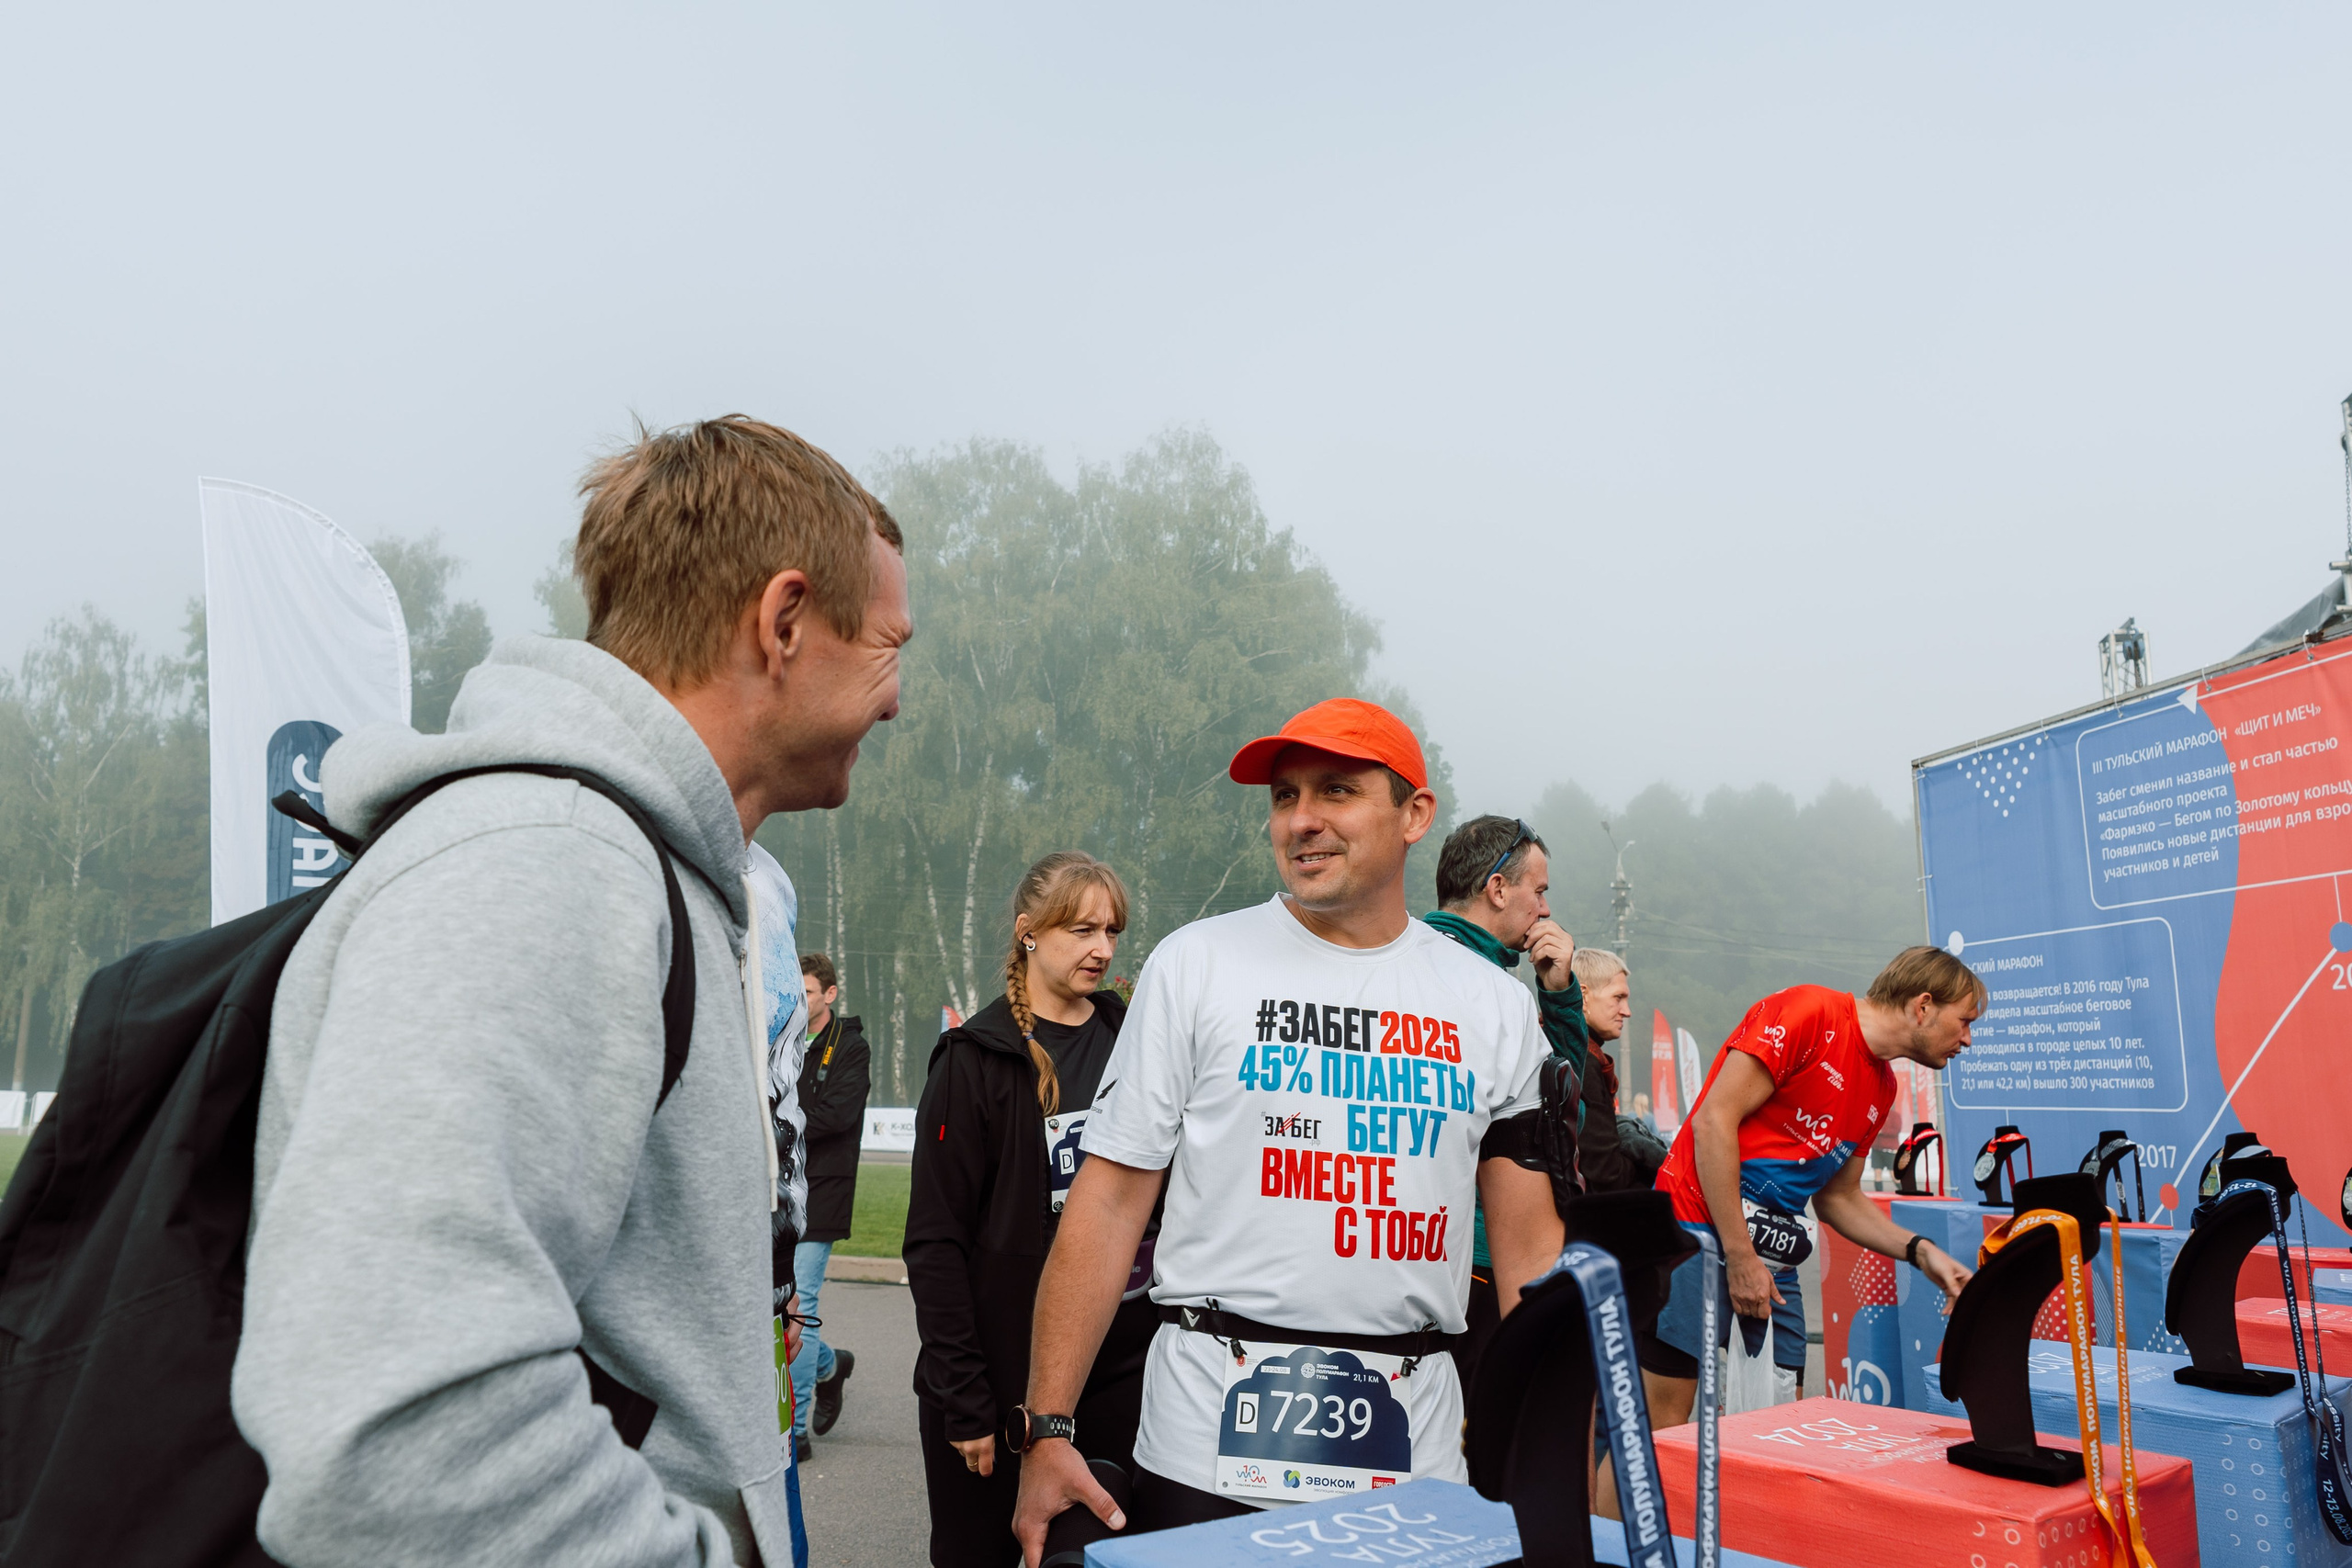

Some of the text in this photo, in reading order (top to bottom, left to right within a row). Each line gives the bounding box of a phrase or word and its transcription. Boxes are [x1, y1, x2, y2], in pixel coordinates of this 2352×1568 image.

[2105, 741, 2163, 771] ТУЛЬСКИЙ
[2166, 727, 2227, 755] МАРАФОН
[2234, 715, 2269, 736] «ЩИТ
[2273, 712, 2283, 727] И
[2286, 703, 2322, 724] МЕЧ»
[2096, 737, 2338, 805] Забег сменил название и стал частью
[2098, 784, 2228, 823] масштабного проекта
[2100, 821, 2155, 840] «Фармэко
[2175, 809, 2211, 827] Бегом
[2215, 805, 2232, 818] по
[2234, 790, 2300, 815] Золотому
[2101, 802, 2352, 861] Появились новые дистанции для взро
[2103, 846, 2219, 883] участников и детей
[1997, 954, 2043, 971] МАРАФОН
[1984, 998, 2132, 1021] увидела масштабное беговое
[1993, 983, 2062, 1002] возвращается!
[2064, 982, 2071, 995] В
[2072, 979, 2096, 994] 2016
[2099, 980, 2123, 994] году
[2125, 976, 2149, 992] Тула
[1972, 1043, 2025, 1056] проводился
[2028, 1043, 2033, 1052] в
[2036, 1041, 2070, 1055] городе
[2073, 1039, 2106, 1053] целых
[2109, 1036, 2121, 1049] 10
[2125, 1038, 2145, 1049] лет.
[2007, 1021, 2055, 1037] марафон,
[2057, 1017, 2101, 1034] который
[1238, 1044, 1476, 1114] 45% ПЛАНЕТЫ
[1960, 1055, 2153, 1075] Пробежать одну из трёх дистанций (10,
[1962, 1075, 2154, 1092] 21,1 или 42,2 км) вышло 300 участников
[1346, 1103, 1448, 1158] БЕГУТ
[1062, 1154, 1072, 1168] D
[1261, 1147, 1396, 1207] ВМЕСТЕ
[2137, 1144, 2177, 1168] 2017
[1334, 1206, 1358, 1258] С
[1758, 1224, 1797, 1254] 7181
[2070, 1254, 2082, 1298] ТУЛА
[1599, 1294, 1625, 1361] ТУЛА
[2283, 1260, 2310, 1396] ПОЛУМАРАФОН ТУЛА
[2075, 1301, 2097, 1433] ПОЛУМАРАФОН
[1239, 1390, 1373, 1441] D 7239
[2120, 1341, 2132, 1470] ПОЛУМАРАФОН
[1702, 1298, 1716, 1568] ЭВОКОМ ПОЛУМАРАФО
[1752, 1417, 1880, 1447] 2024
[1826, 1433, 1922, 1452] ТУЛА
[1611, 1362, 1658, 1548] ПОЛУМАРАФОН
[1306, 1476, 1355, 1489] ЭВОКОМ
[2125, 1475, 2136, 1517] ТУЛА
[1250, 1503, 1438, 1557] 2025
[1330, 1529, 1476, 1563] ТУЛА
